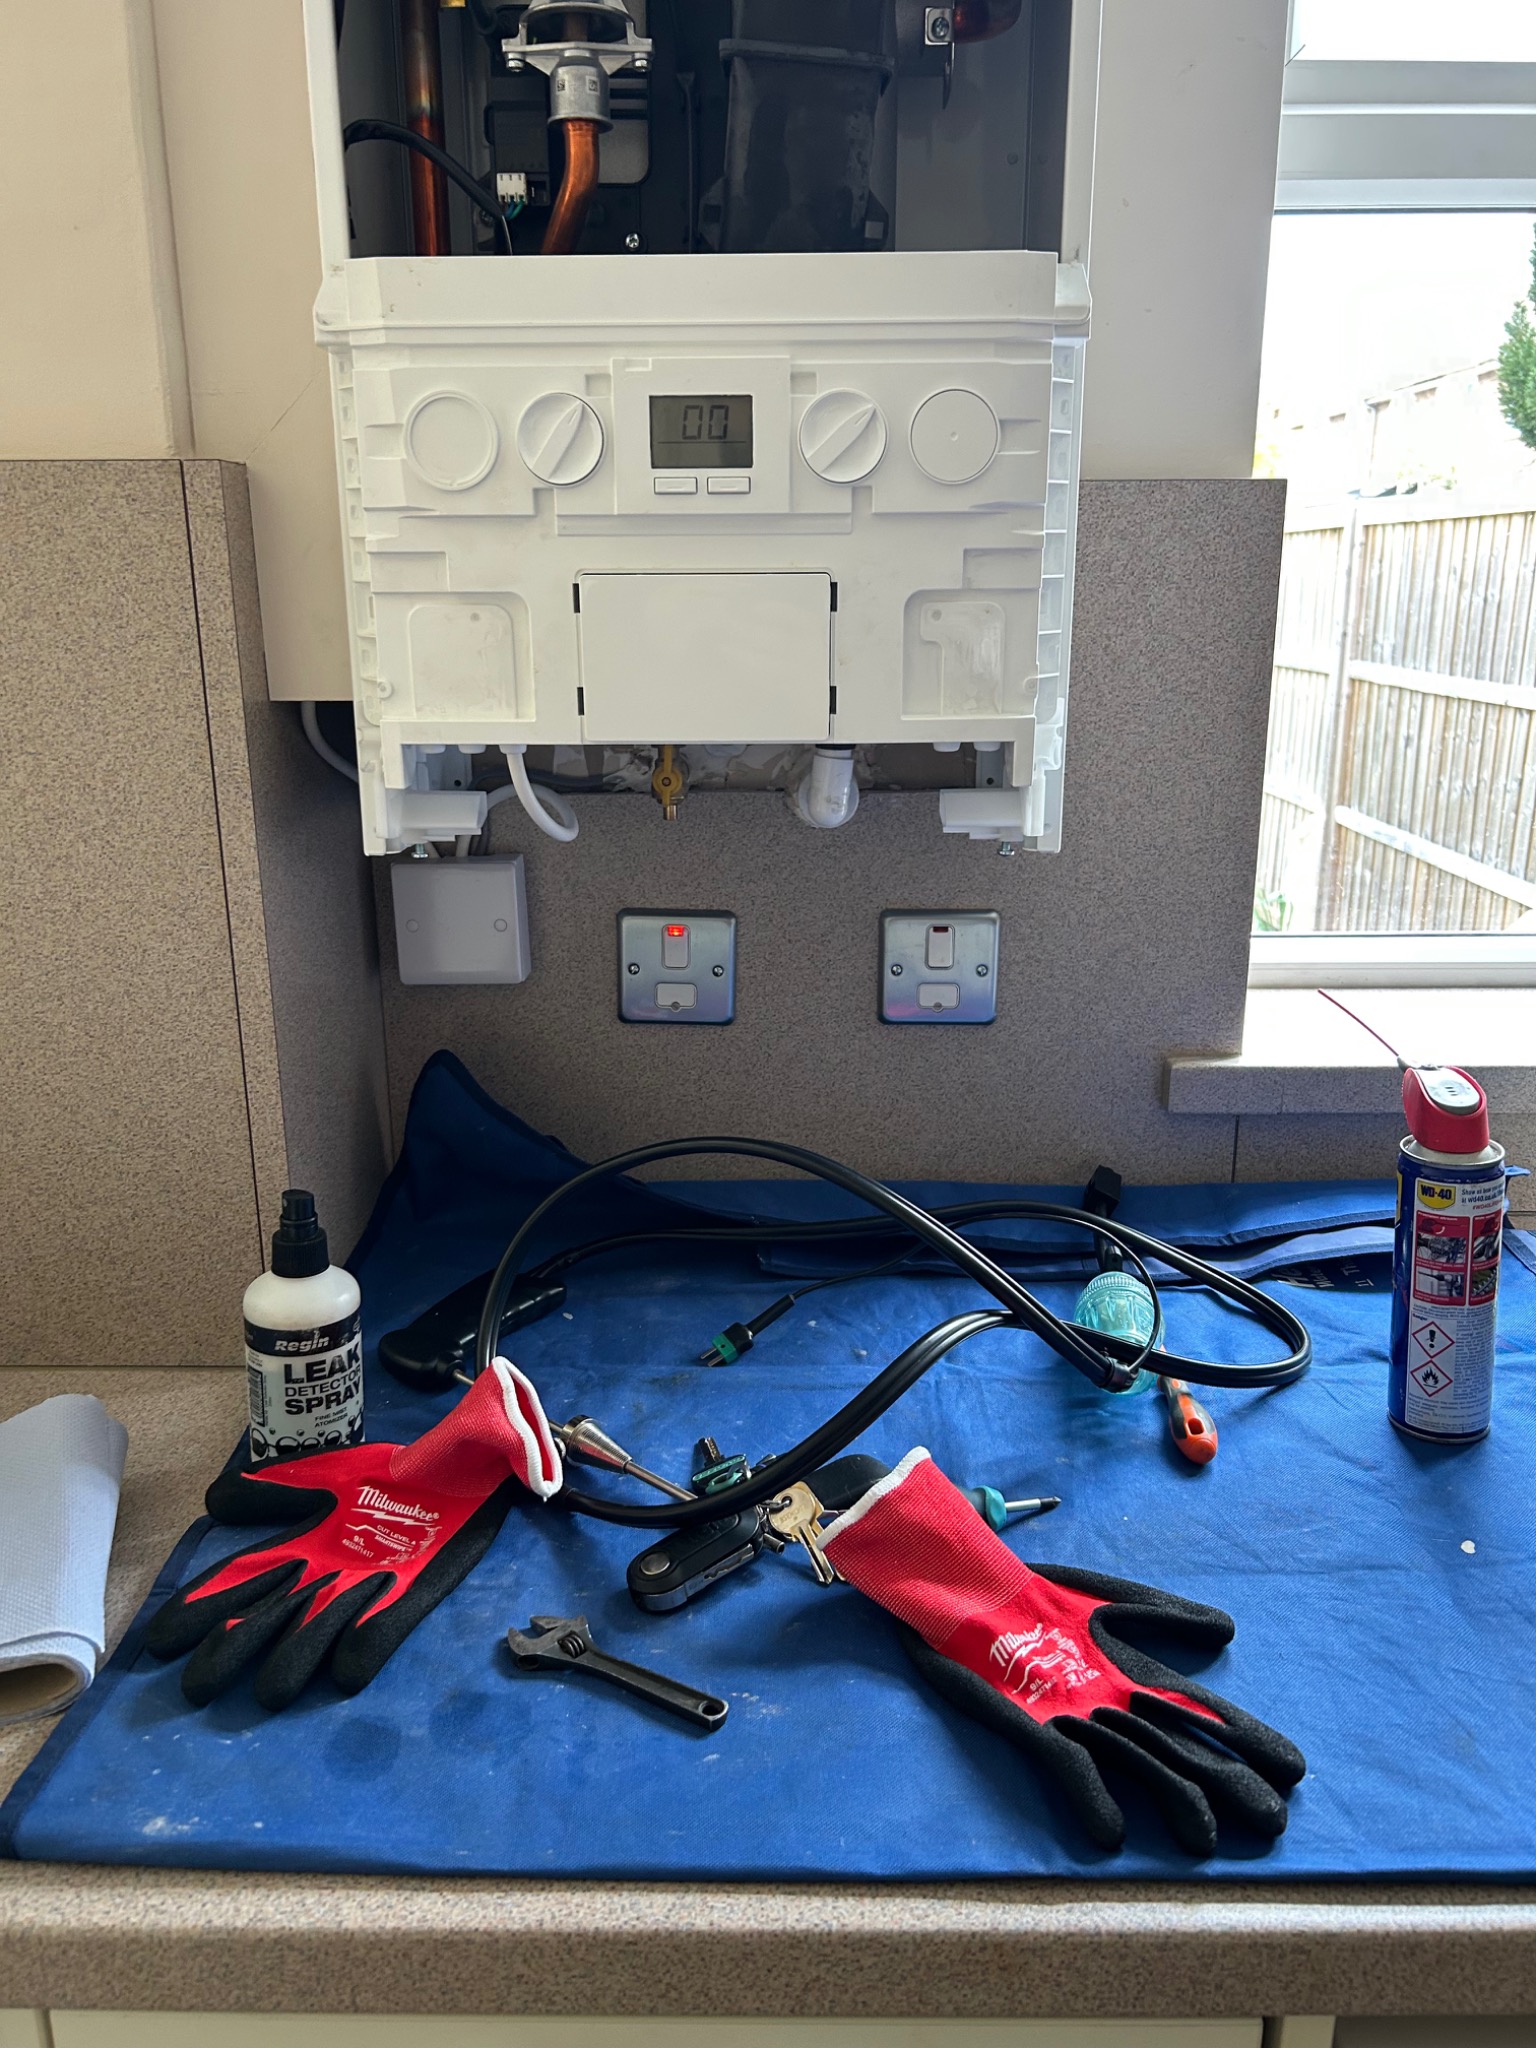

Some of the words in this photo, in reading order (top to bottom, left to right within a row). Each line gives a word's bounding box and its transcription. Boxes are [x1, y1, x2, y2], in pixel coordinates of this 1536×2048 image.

[682, 404, 729, 440] 00
[1420, 1184, 1453, 1200] WD-40
[274, 1331, 330, 1352] Regin
[283, 1342, 361, 1385] LEAK
[284, 1364, 361, 1397] DETECTOR
[284, 1376, 361, 1415] SPRAY
[314, 1413, 332, 1422] FINE
[357, 1485, 439, 1522] Milwaukee
[376, 1524, 390, 1536] CUT
[390, 1531, 410, 1545] LEVEL
